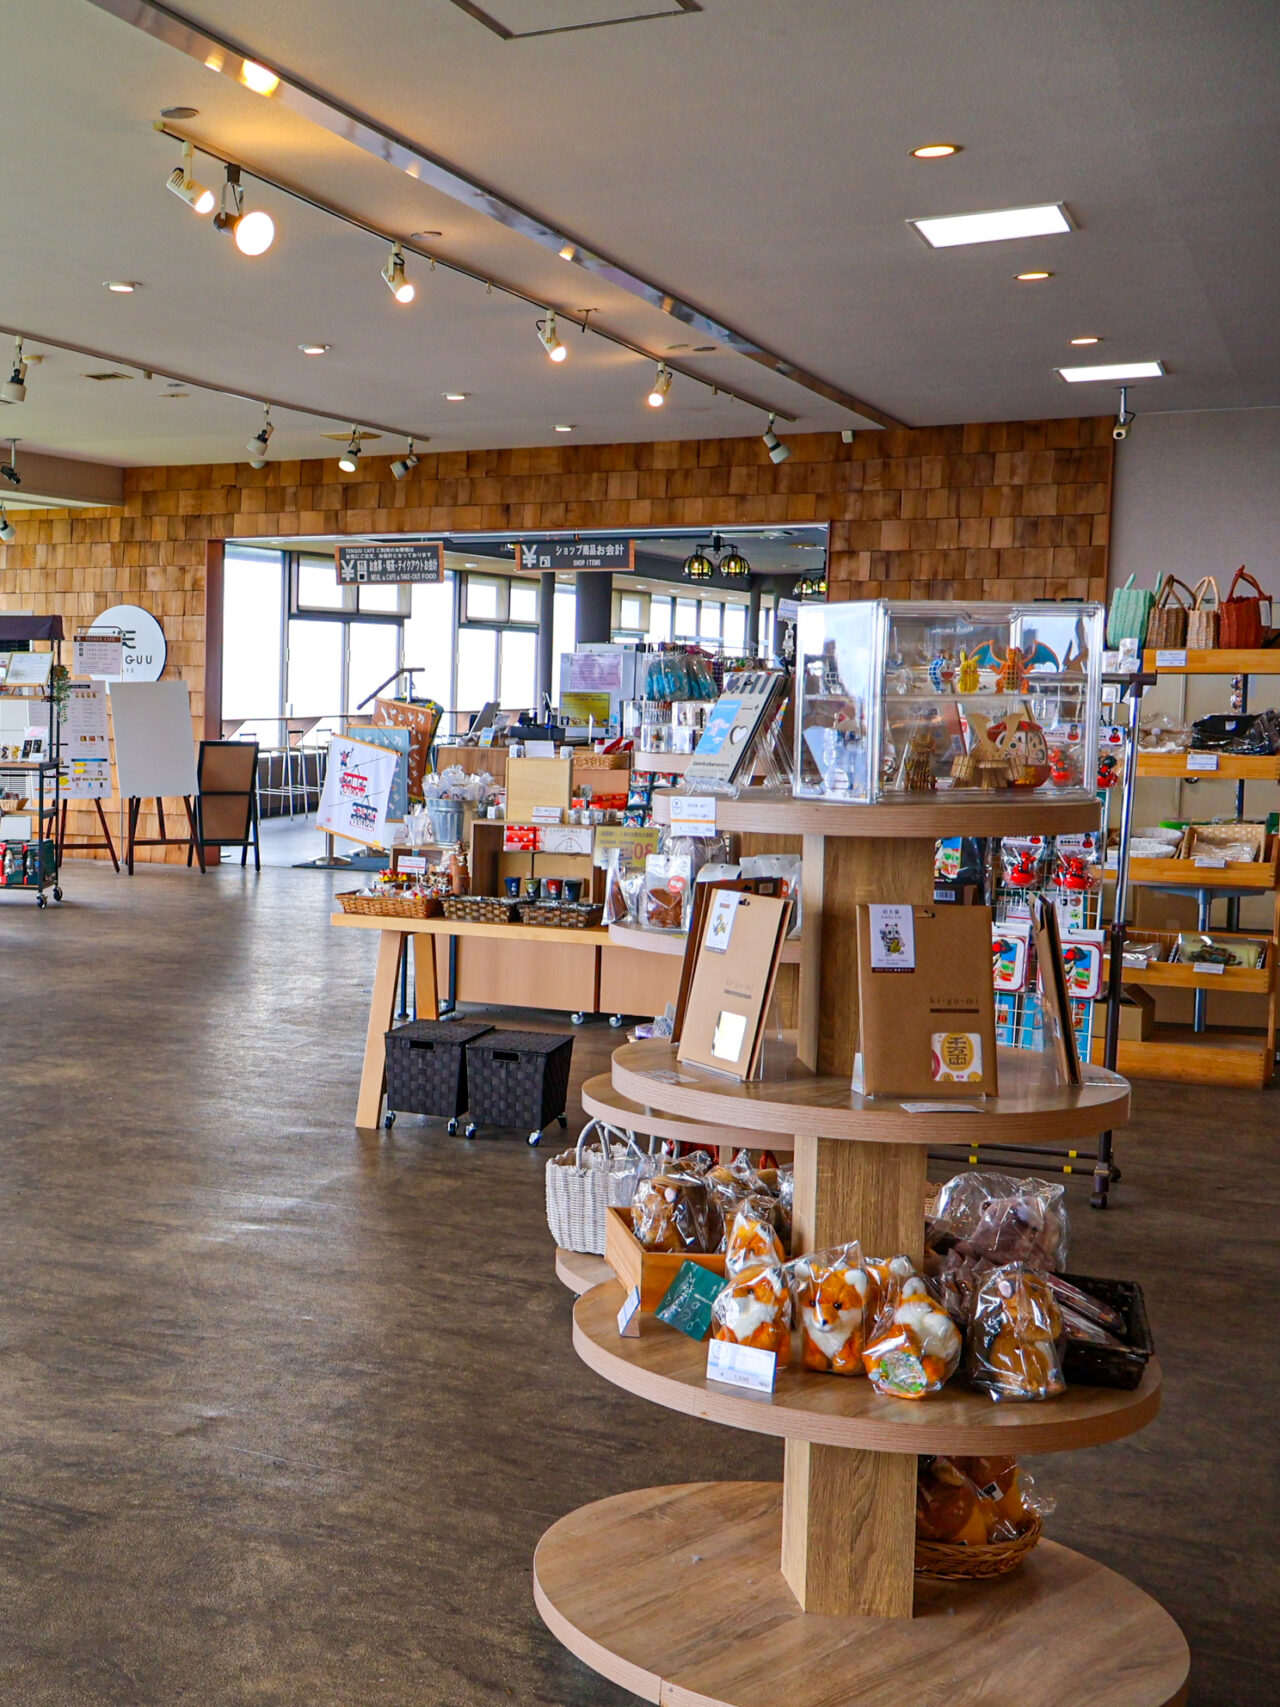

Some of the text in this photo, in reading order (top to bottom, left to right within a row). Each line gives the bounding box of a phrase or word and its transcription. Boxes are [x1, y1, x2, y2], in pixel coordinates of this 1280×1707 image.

[555, 544, 624, 556] ショップ商品お会計
[125, 655, 152, 664] GUU
